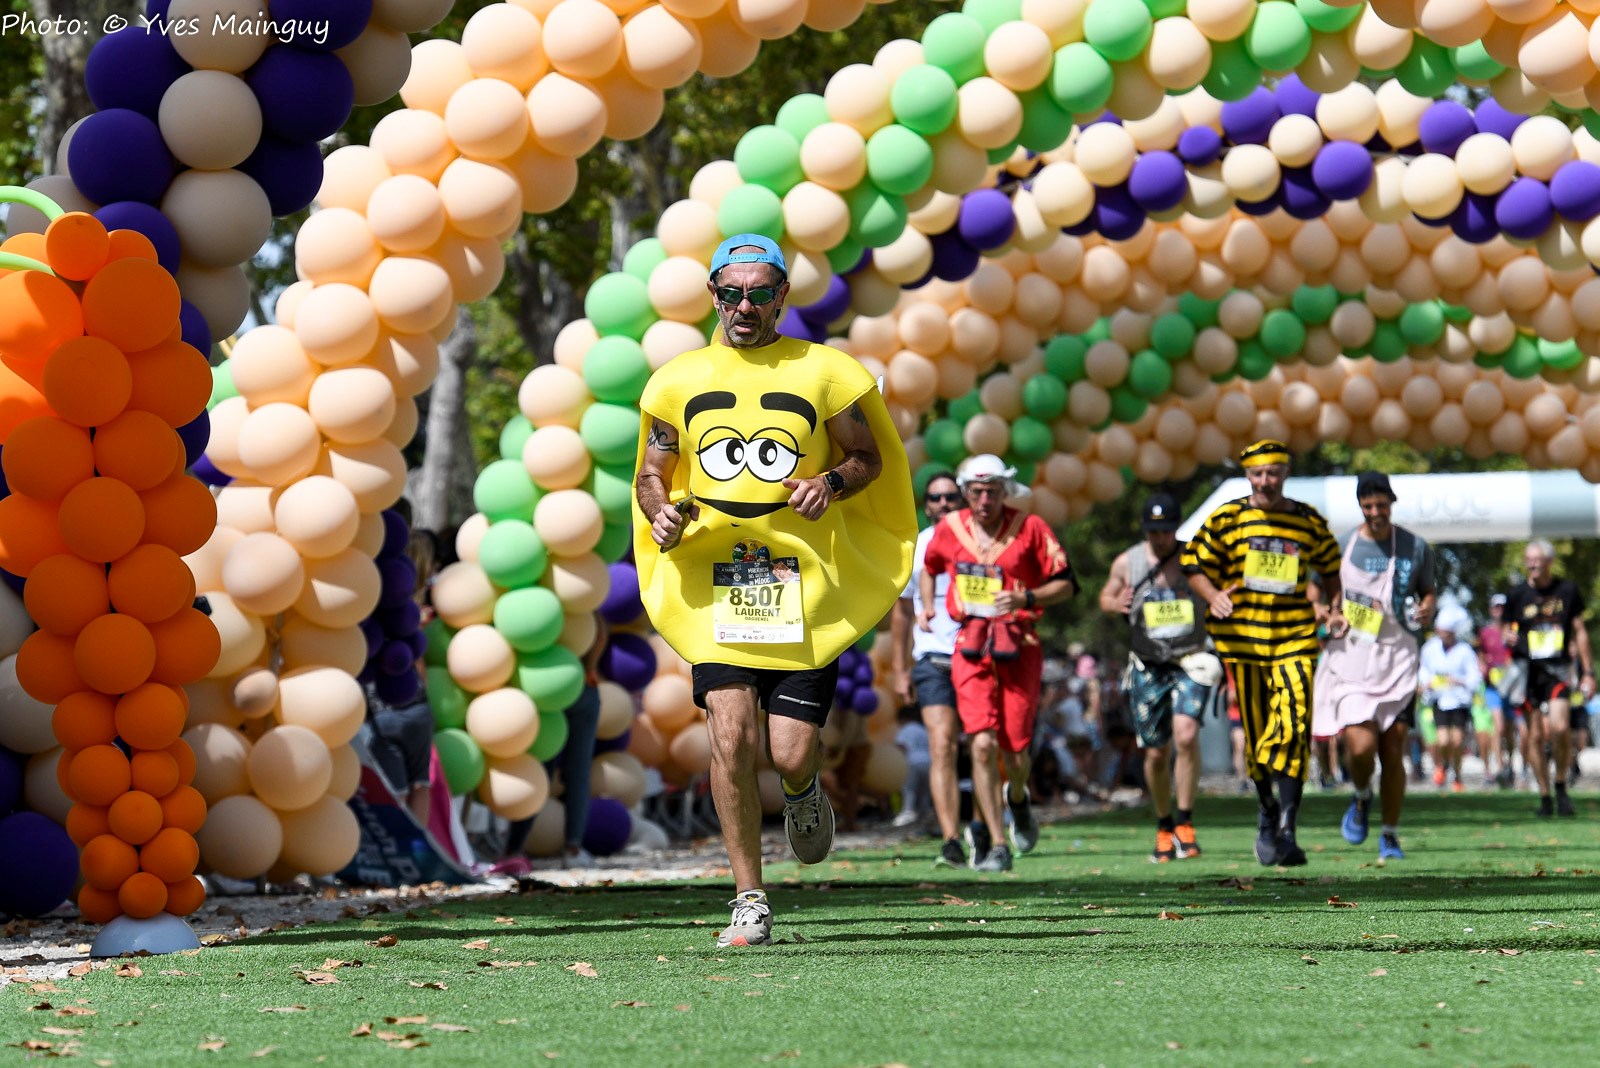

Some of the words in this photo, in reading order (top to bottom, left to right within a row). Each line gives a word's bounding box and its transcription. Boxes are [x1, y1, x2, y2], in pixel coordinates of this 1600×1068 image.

[1259, 551, 1286, 568] 337
[729, 584, 785, 607] 8507
[735, 607, 781, 617] LAURENT
